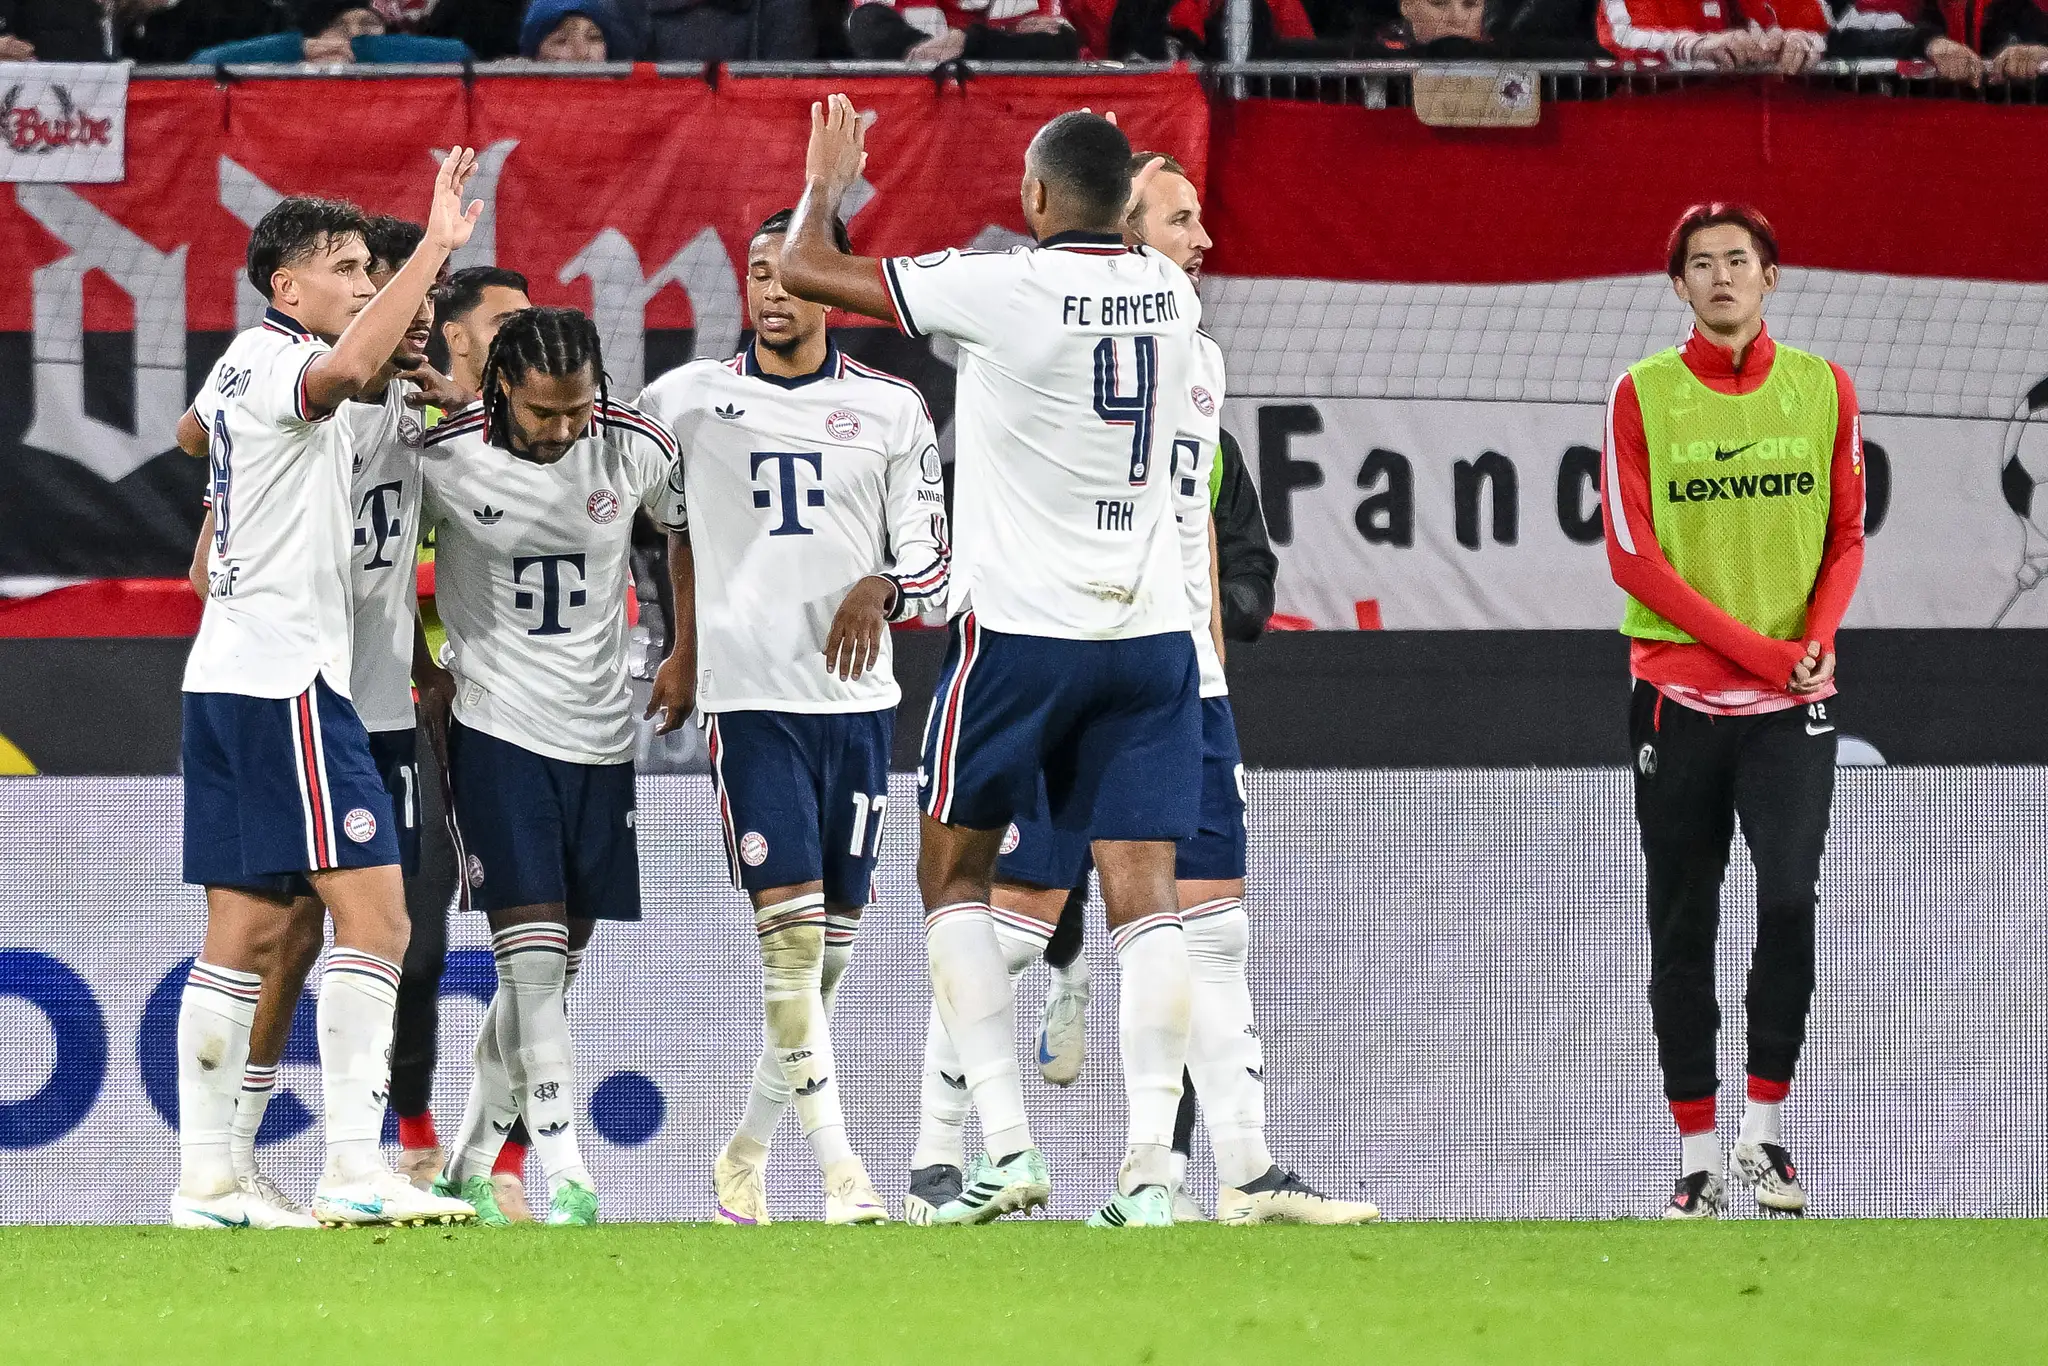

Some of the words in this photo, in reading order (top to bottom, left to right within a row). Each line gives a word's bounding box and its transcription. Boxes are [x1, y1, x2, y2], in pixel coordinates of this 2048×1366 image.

[1064, 295, 1091, 325] FC
[1102, 290, 1180, 325] BAYERN
[1093, 335, 1158, 486] 4
[1668, 471, 1815, 503] Lexware
[1096, 500, 1134, 531] TAH
[1807, 703, 1827, 720] 42
[400, 762, 422, 828] 1
[850, 791, 887, 857] 17
